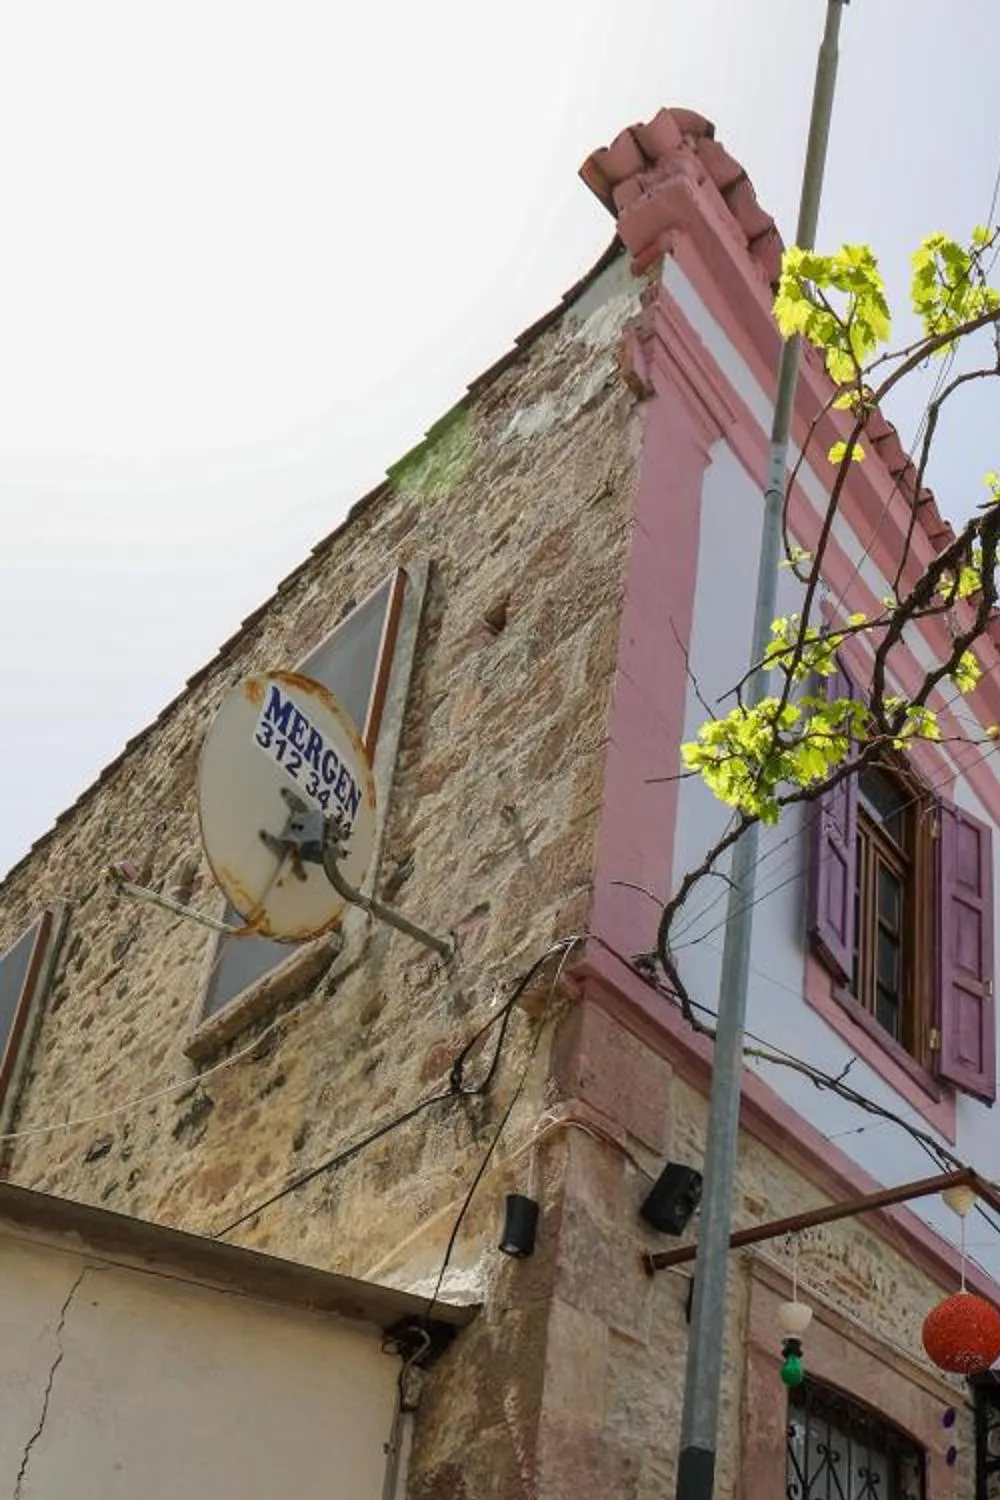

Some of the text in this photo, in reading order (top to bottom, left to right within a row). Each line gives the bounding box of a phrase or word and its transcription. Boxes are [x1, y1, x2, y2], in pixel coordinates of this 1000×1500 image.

[256, 721, 303, 778] 312
[305, 771, 331, 811] 34
[264, 686, 362, 820] MERGEN
